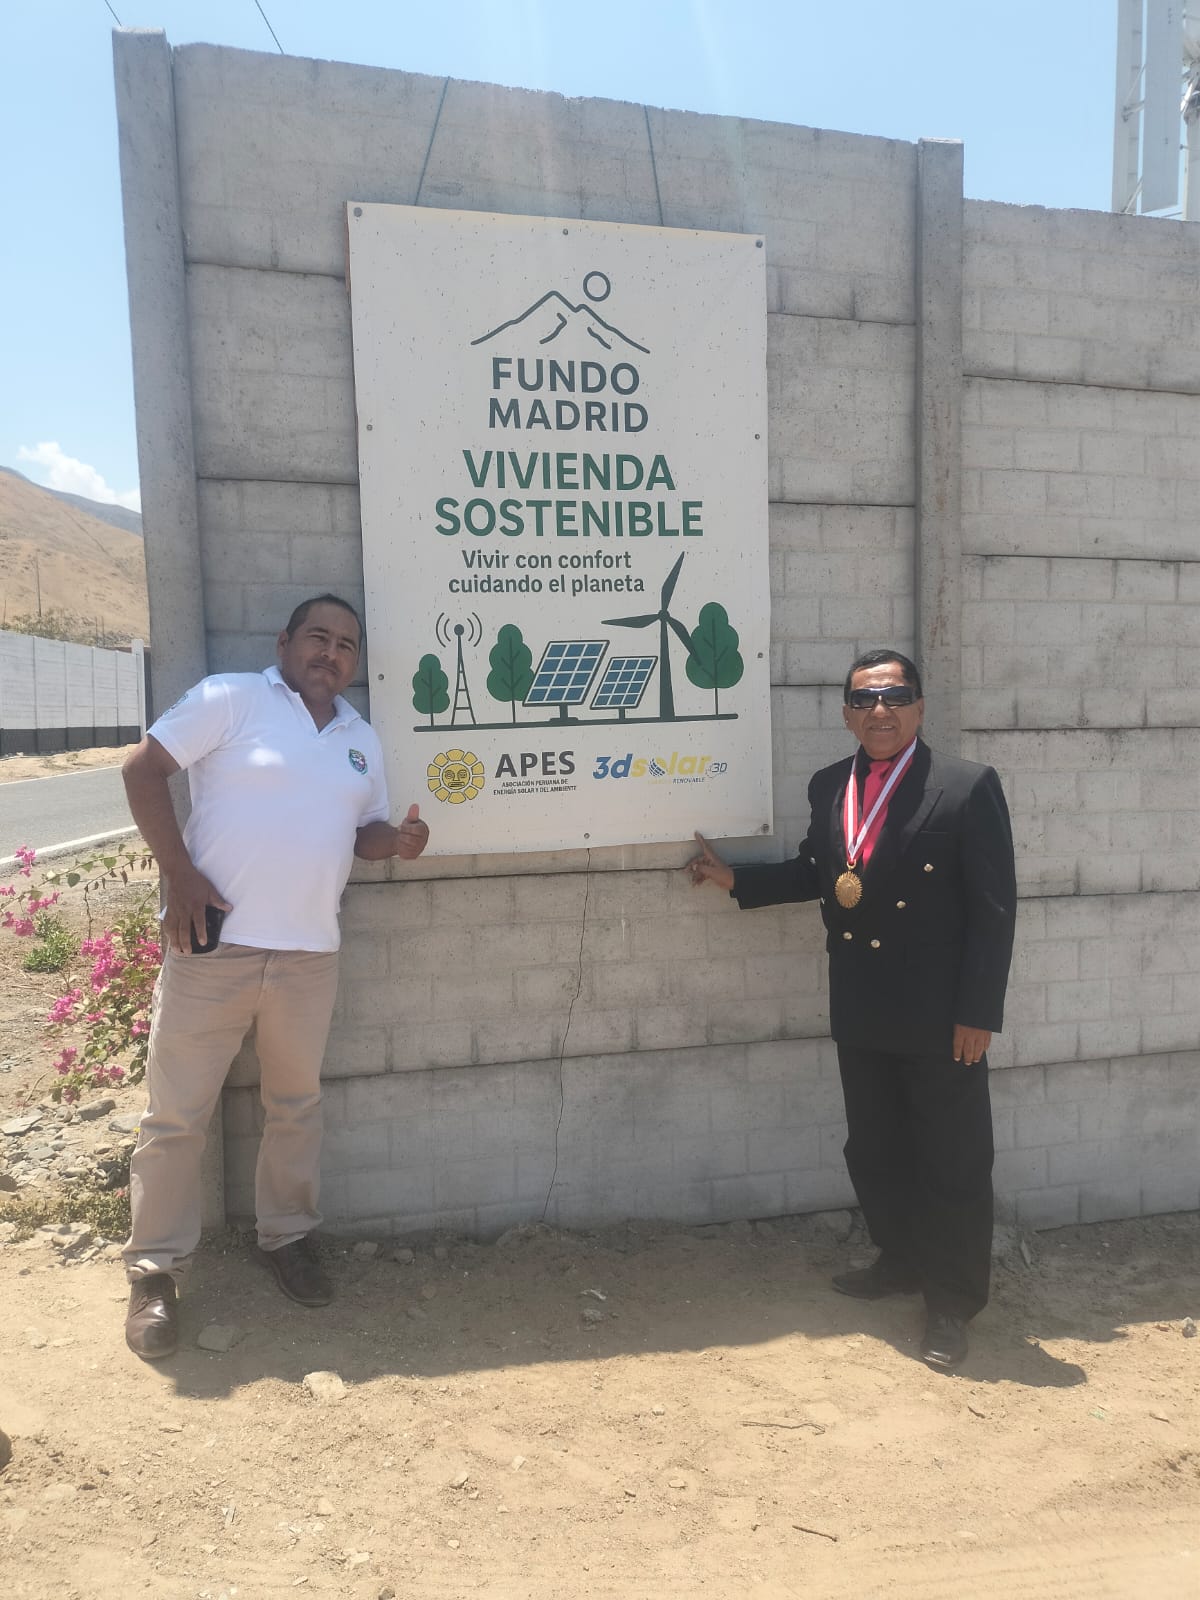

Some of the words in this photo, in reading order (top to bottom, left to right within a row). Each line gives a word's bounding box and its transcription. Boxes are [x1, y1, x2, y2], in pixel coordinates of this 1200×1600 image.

[492, 357, 640, 395] FUNDO
[488, 397, 649, 433] MADRID
[462, 449, 676, 491] VIVIENDA
[434, 497, 704, 537] SOSTENIBLE
[462, 549, 510, 569] Vivir
[515, 554, 552, 569] con
[558, 550, 632, 569] confort
[448, 574, 543, 593] cuidando
[549, 575, 566, 593] el
[572, 575, 645, 597] planeta
[495, 751, 576, 778] APES
[502, 779, 535, 788] ASOCIACIÓN
[517, 786, 535, 794] SOLAR
